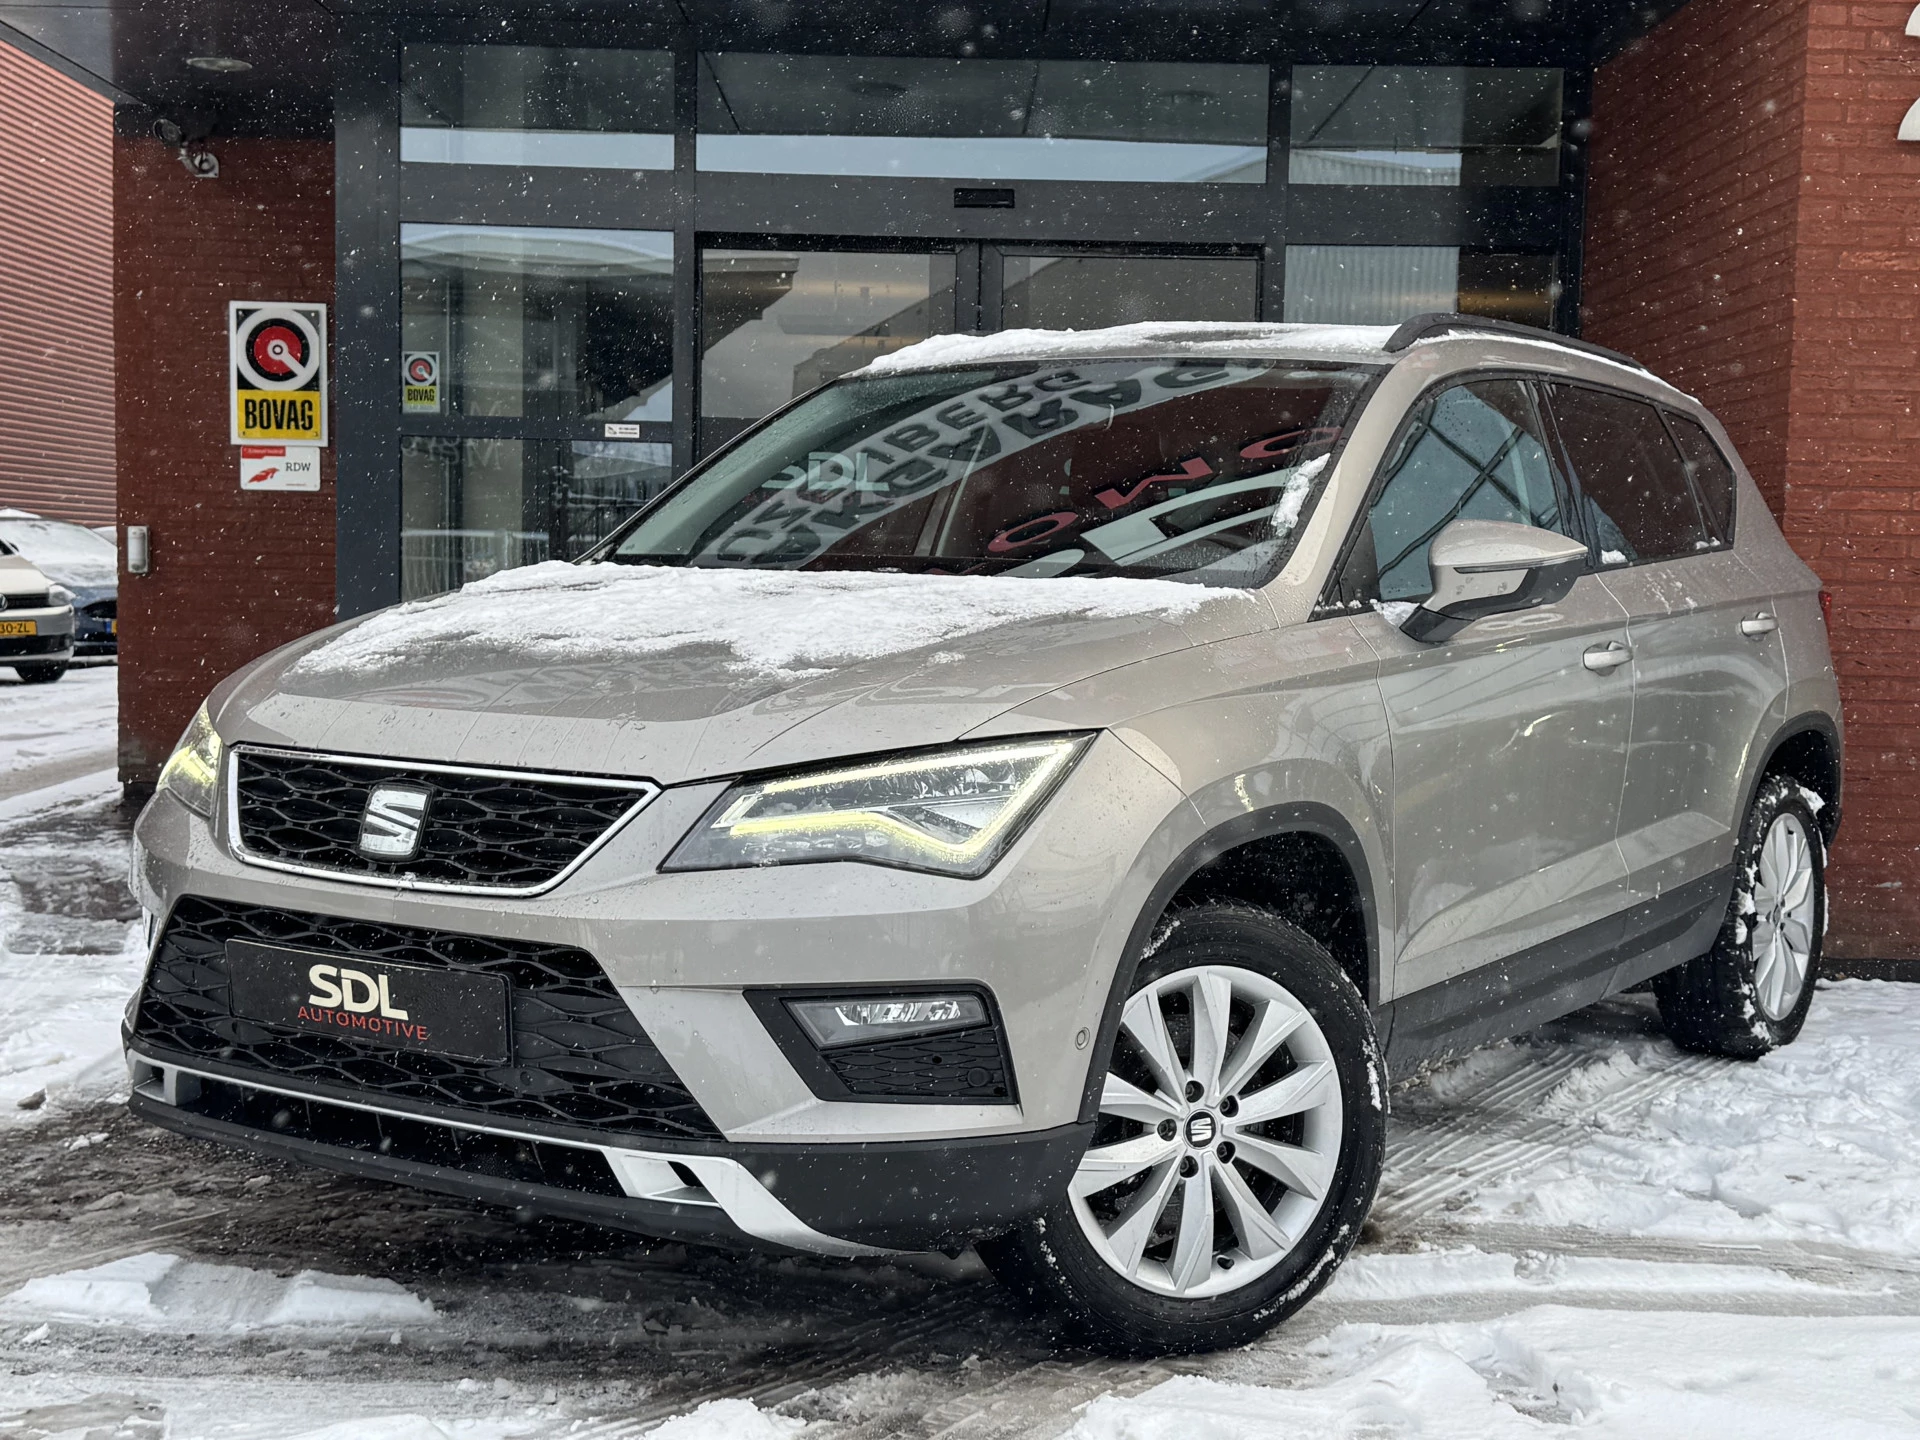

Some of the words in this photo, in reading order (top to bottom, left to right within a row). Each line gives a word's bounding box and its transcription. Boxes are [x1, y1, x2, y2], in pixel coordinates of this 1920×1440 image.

[408, 388, 435, 401] BOVAG
[244, 398, 313, 431] BOVAG
[285, 462, 311, 472] RDW
[308, 963, 409, 1021] SDL
[297, 1006, 428, 1041] AUTOMOTIVE
